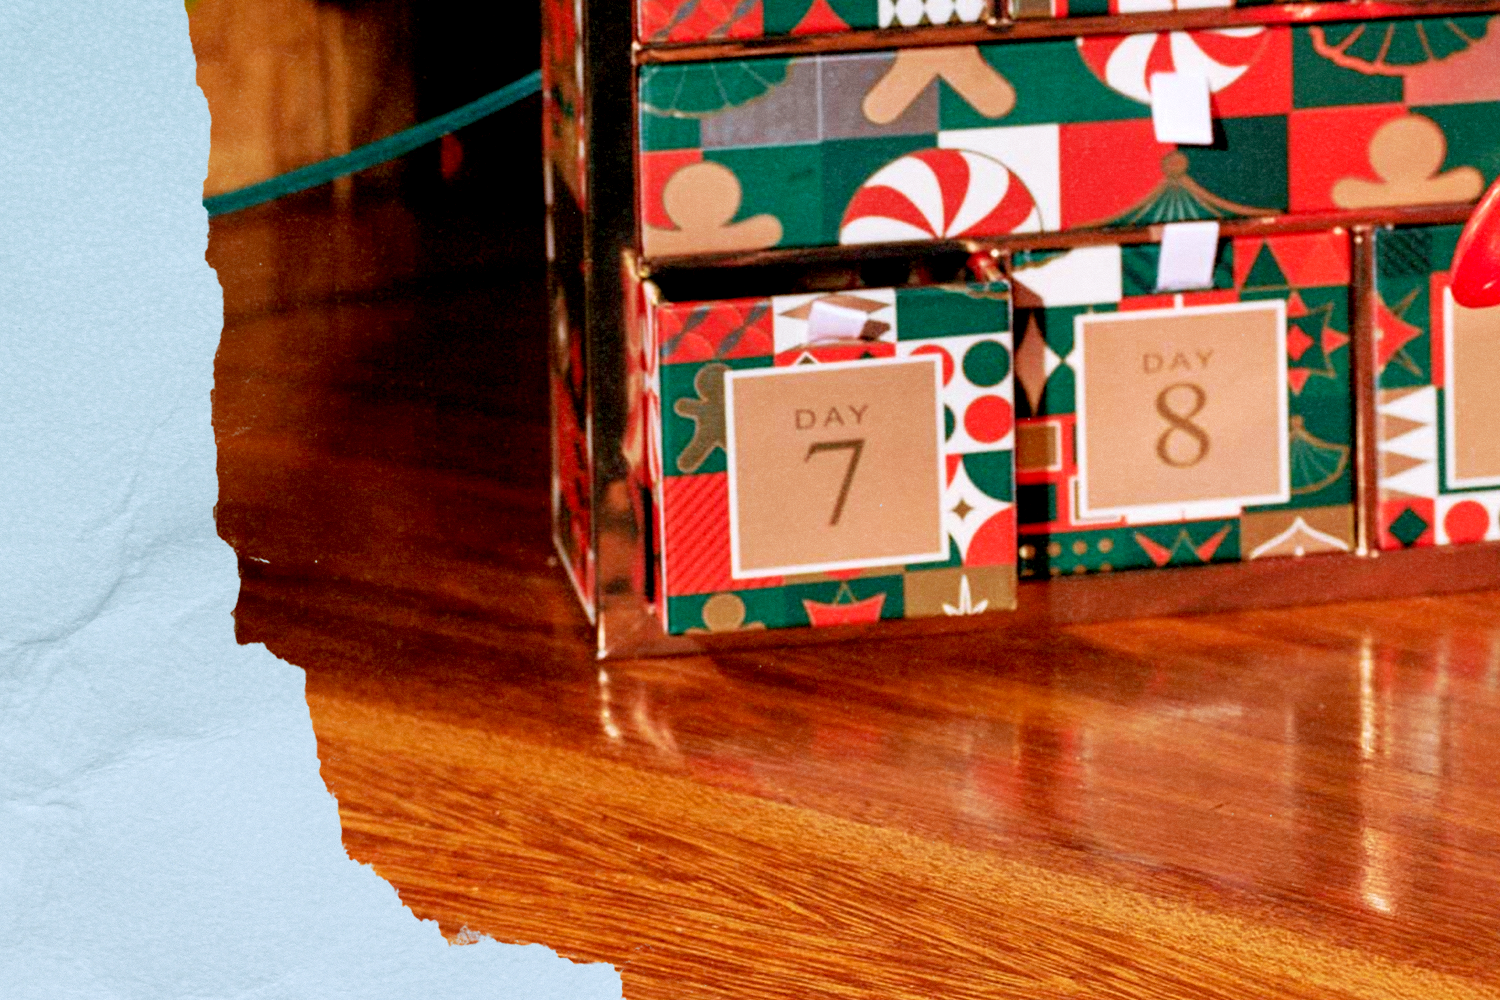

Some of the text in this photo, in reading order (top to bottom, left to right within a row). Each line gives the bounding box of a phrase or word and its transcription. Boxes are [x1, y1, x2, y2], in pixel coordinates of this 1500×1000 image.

[1142, 348, 1214, 374] DAY
[795, 403, 868, 430] DAY
[1156, 382, 1210, 469] 8
[803, 438, 865, 526] 7
